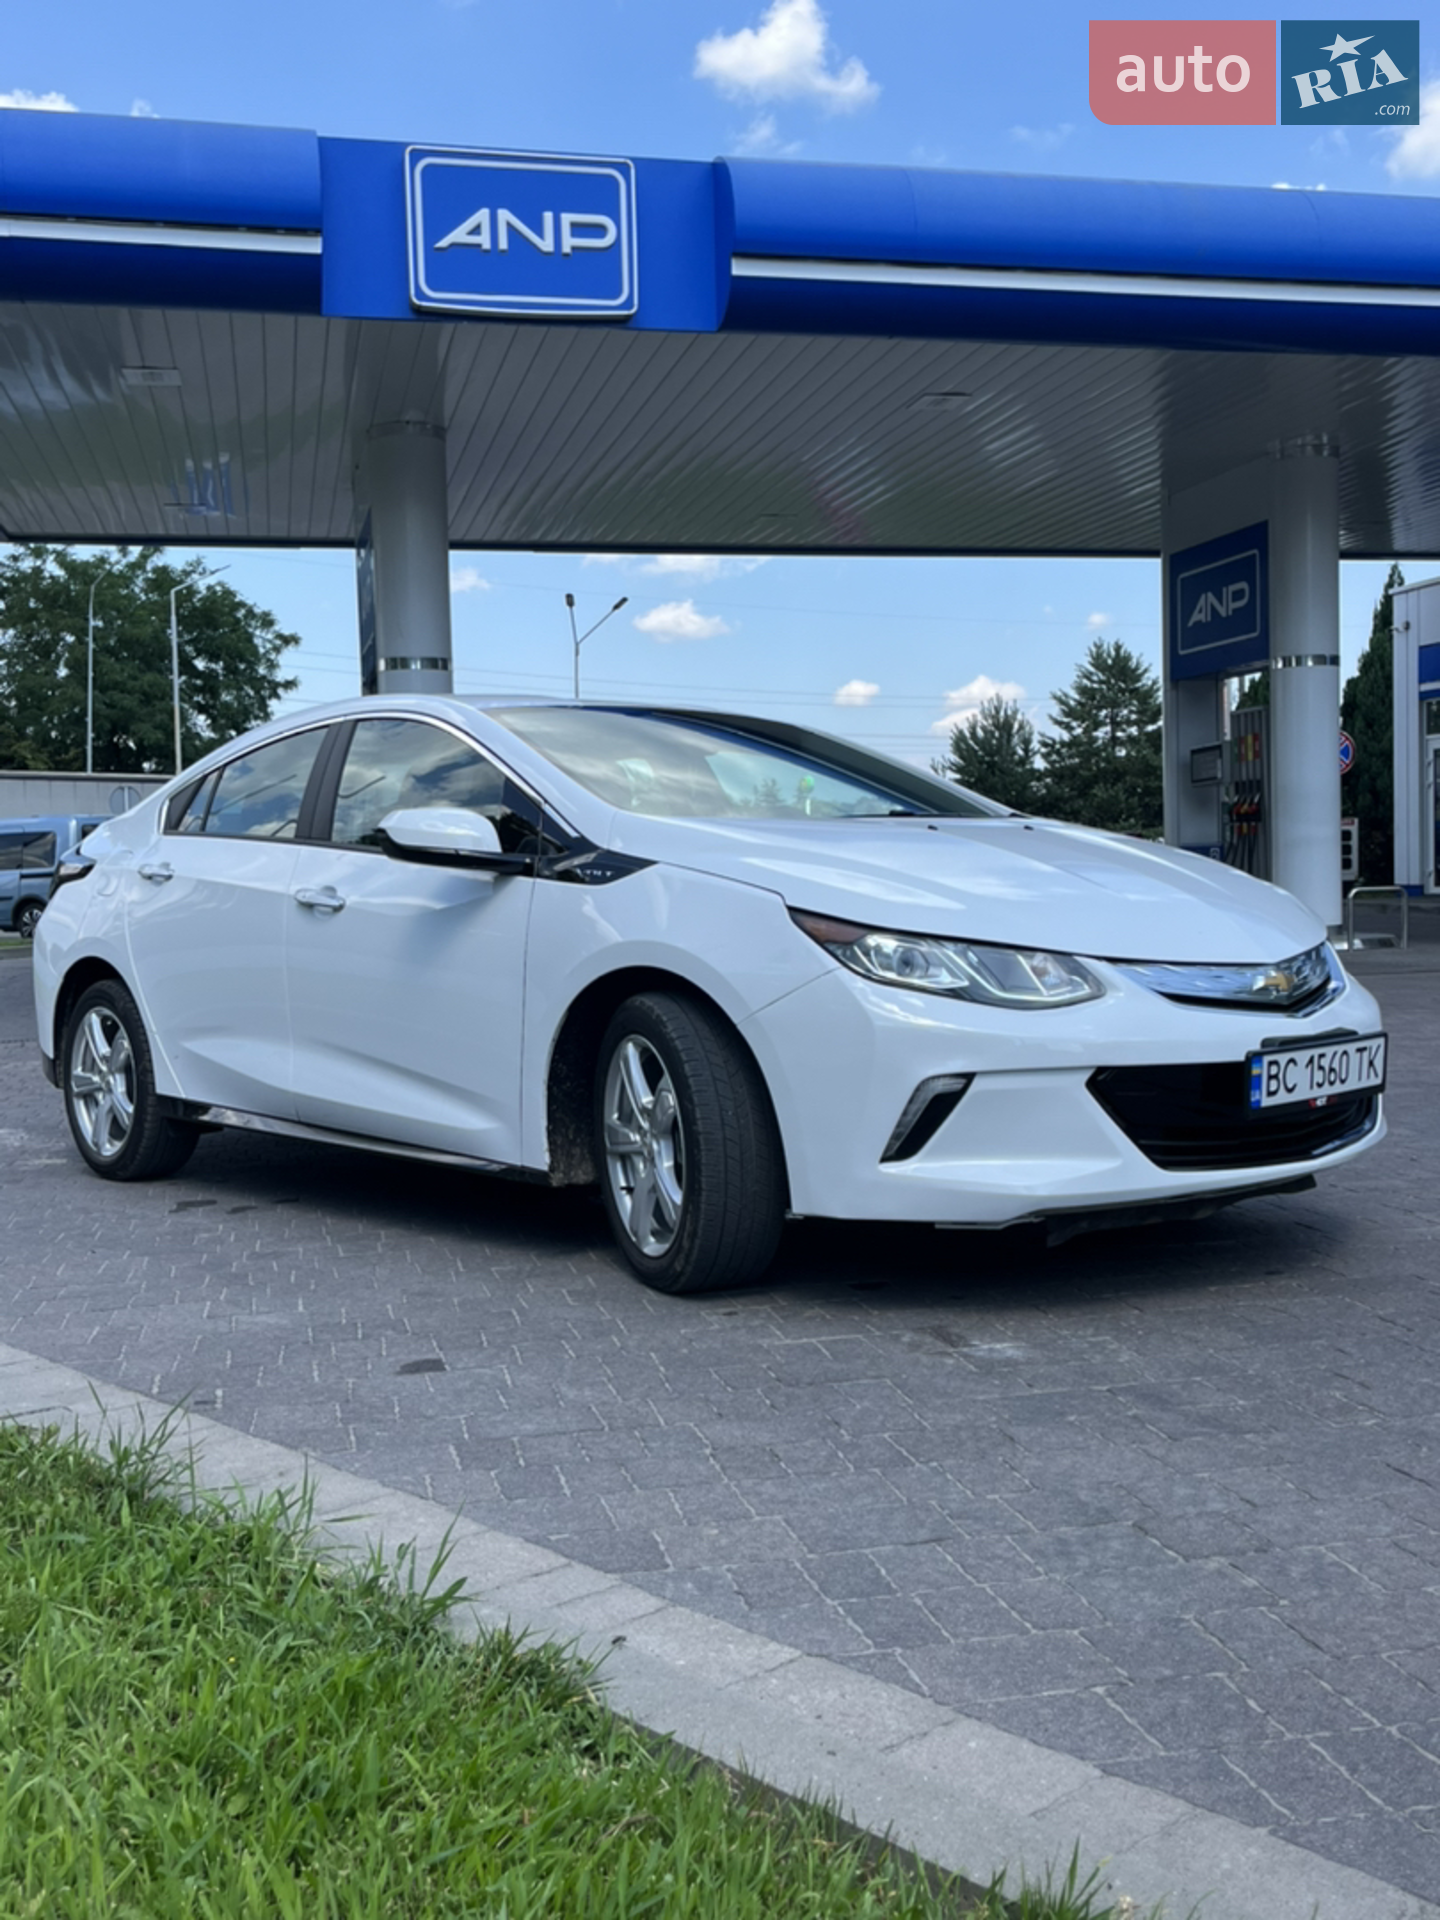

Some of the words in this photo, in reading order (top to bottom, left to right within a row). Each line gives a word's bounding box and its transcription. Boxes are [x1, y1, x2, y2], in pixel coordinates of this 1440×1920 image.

[433, 208, 618, 255] ANP
[1187, 581, 1249, 627] ANP
[1266, 1057, 1298, 1098] BC
[1305, 1050, 1350, 1090] 1560
[1355, 1044, 1382, 1082] TK
